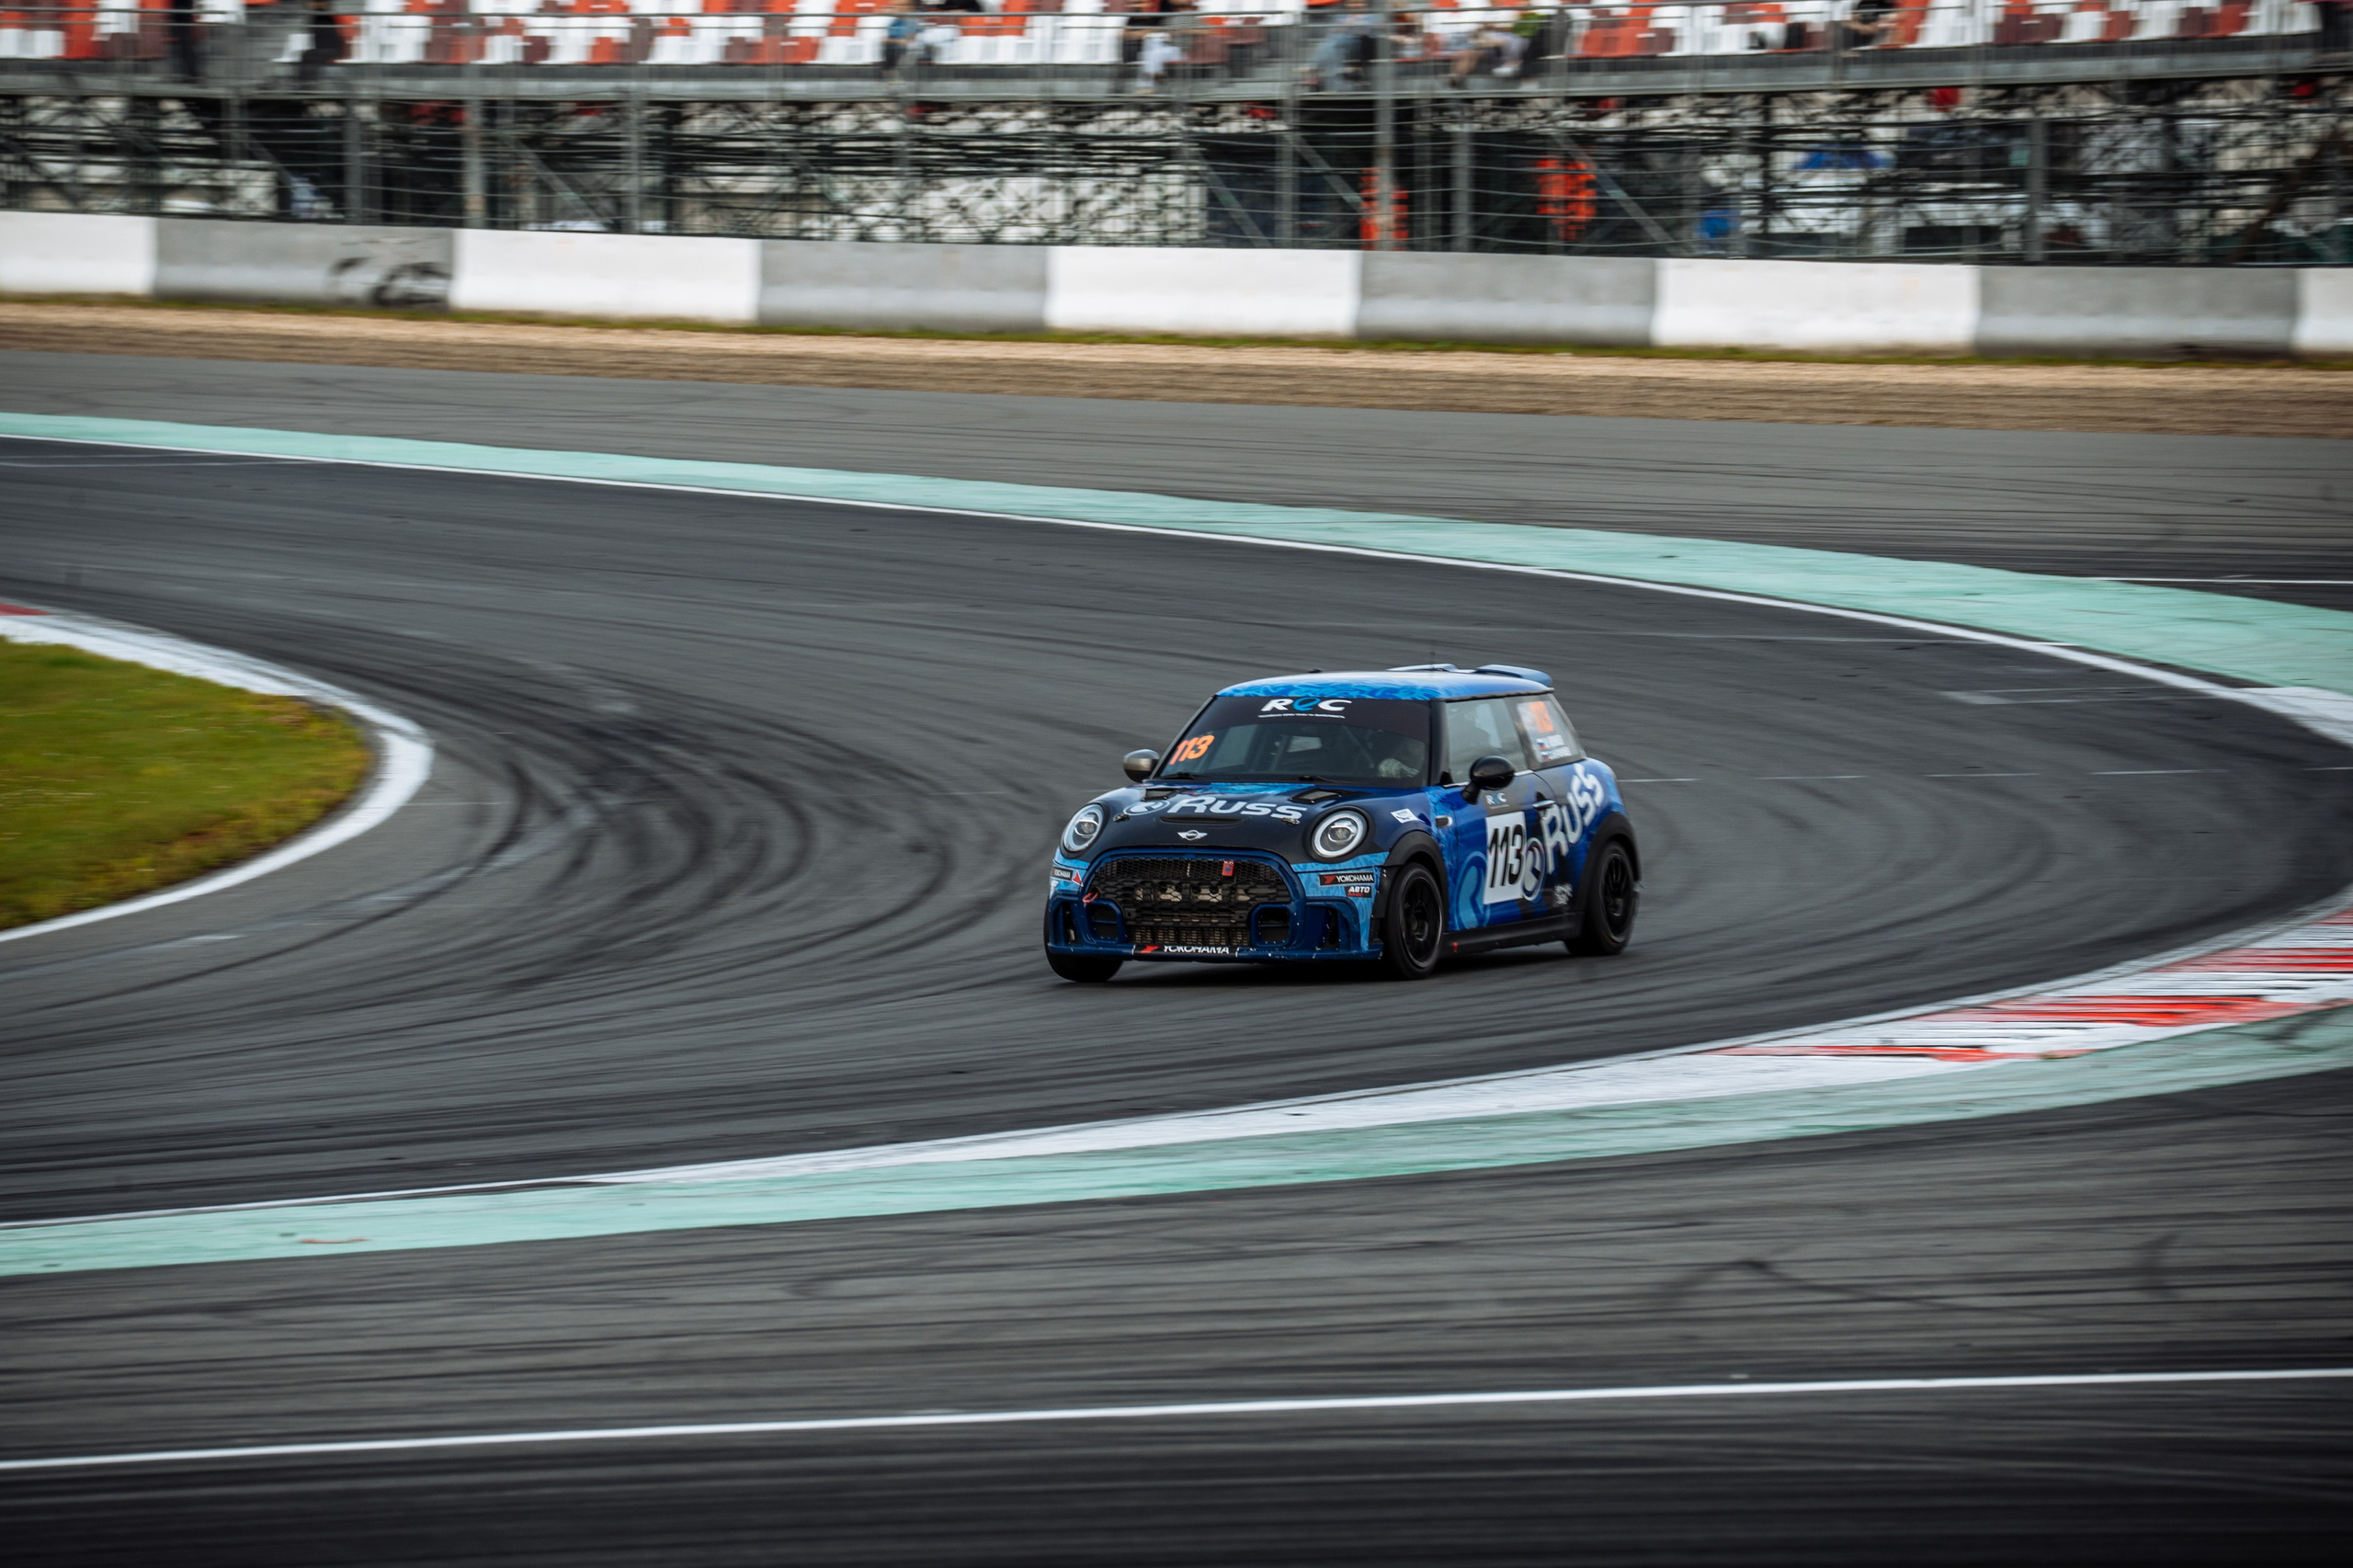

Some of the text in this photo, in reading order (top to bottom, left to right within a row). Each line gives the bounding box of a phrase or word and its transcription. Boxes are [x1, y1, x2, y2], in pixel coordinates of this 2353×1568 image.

[1168, 734, 1215, 765] 113
[1488, 824, 1527, 888] 113
[1336, 874, 1374, 882] YOKOHAMA
[1164, 945, 1230, 954] YOKOHAMA
